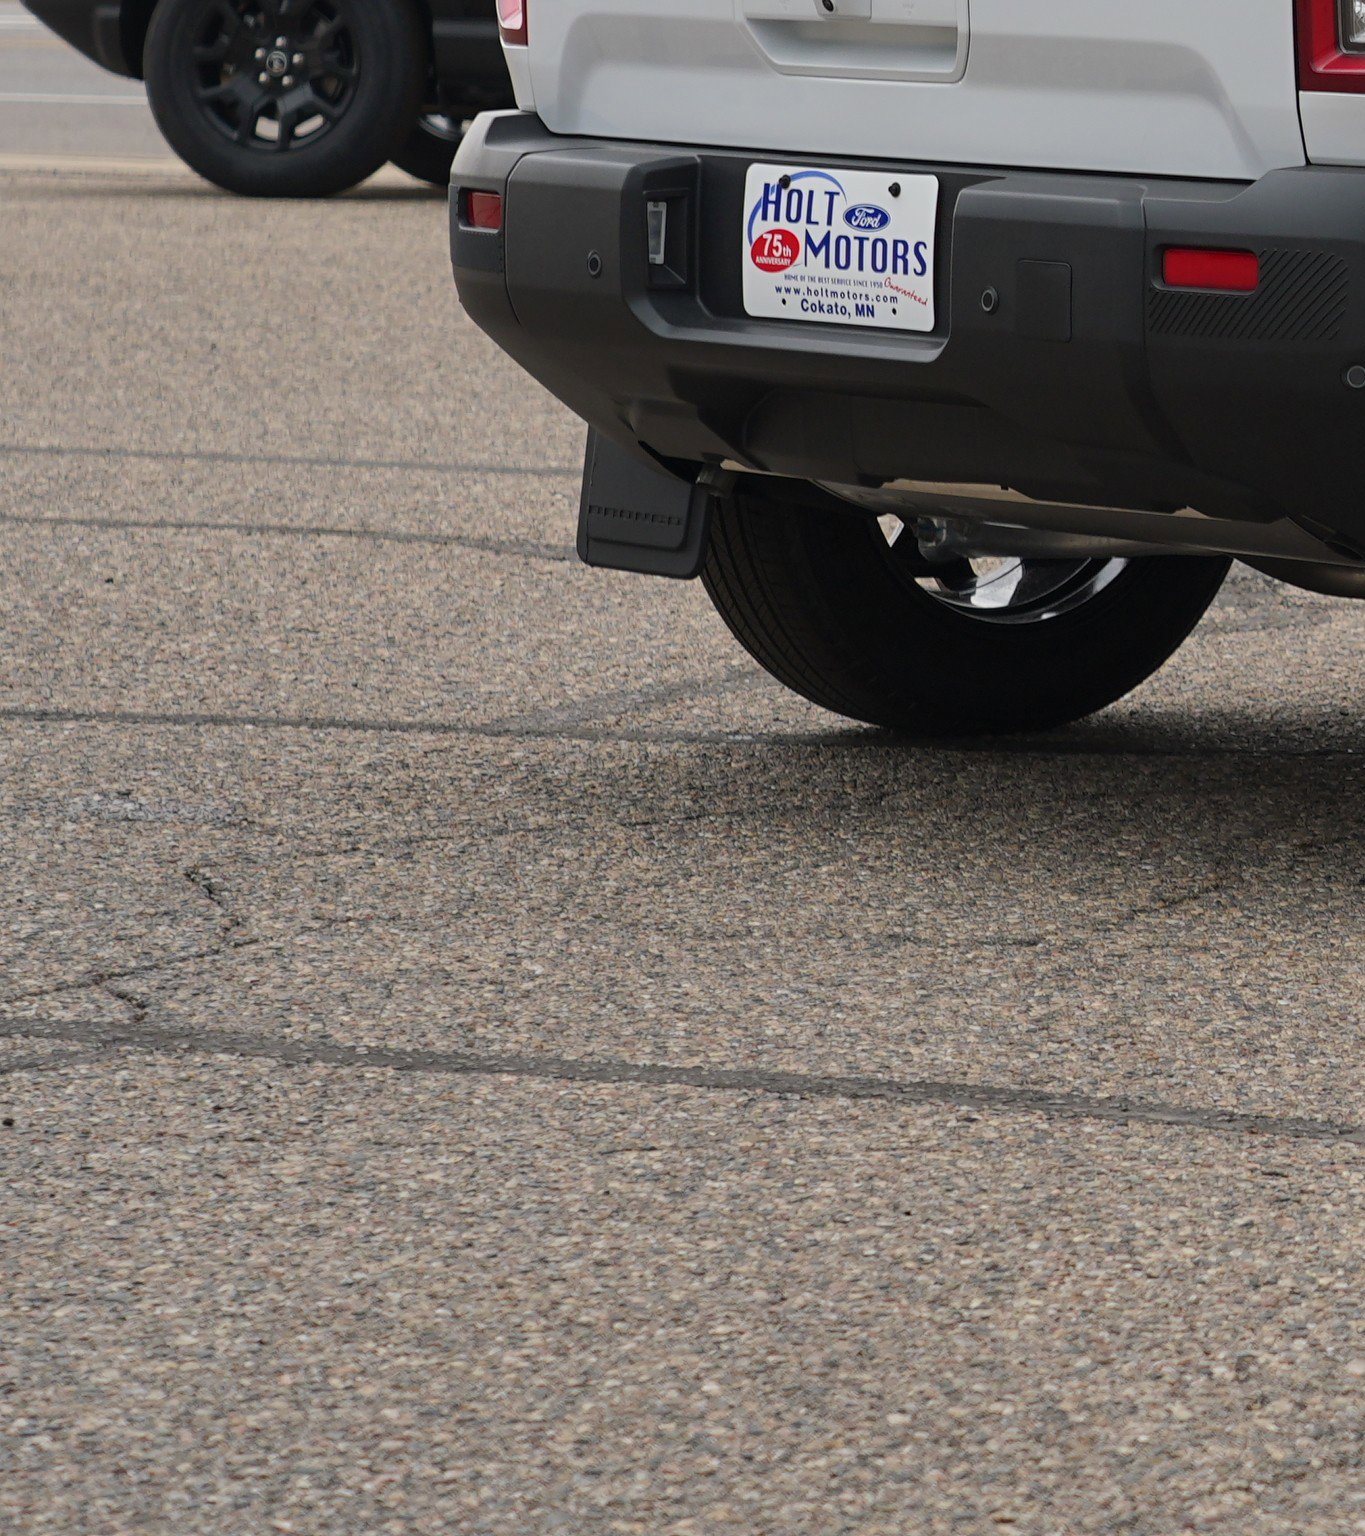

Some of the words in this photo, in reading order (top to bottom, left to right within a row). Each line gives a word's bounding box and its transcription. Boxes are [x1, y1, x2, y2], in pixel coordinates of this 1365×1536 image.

[761, 182, 840, 226] HOLT
[851, 207, 882, 229] Ford
[762, 233, 792, 258] 75th
[804, 227, 928, 277] MOTORS
[755, 256, 791, 266] ANNIVERSARY
[784, 274, 799, 282] HOME
[807, 275, 816, 283] THE
[819, 276, 830, 284] BEST
[831, 277, 851, 286] SERVICE
[853, 279, 868, 287] SINCE
[884, 276, 928, 306] Guaranteed
[775, 285, 898, 304] www.holtmotors.com
[801, 298, 851, 319] Cokato,
[855, 304, 875, 318] MN
